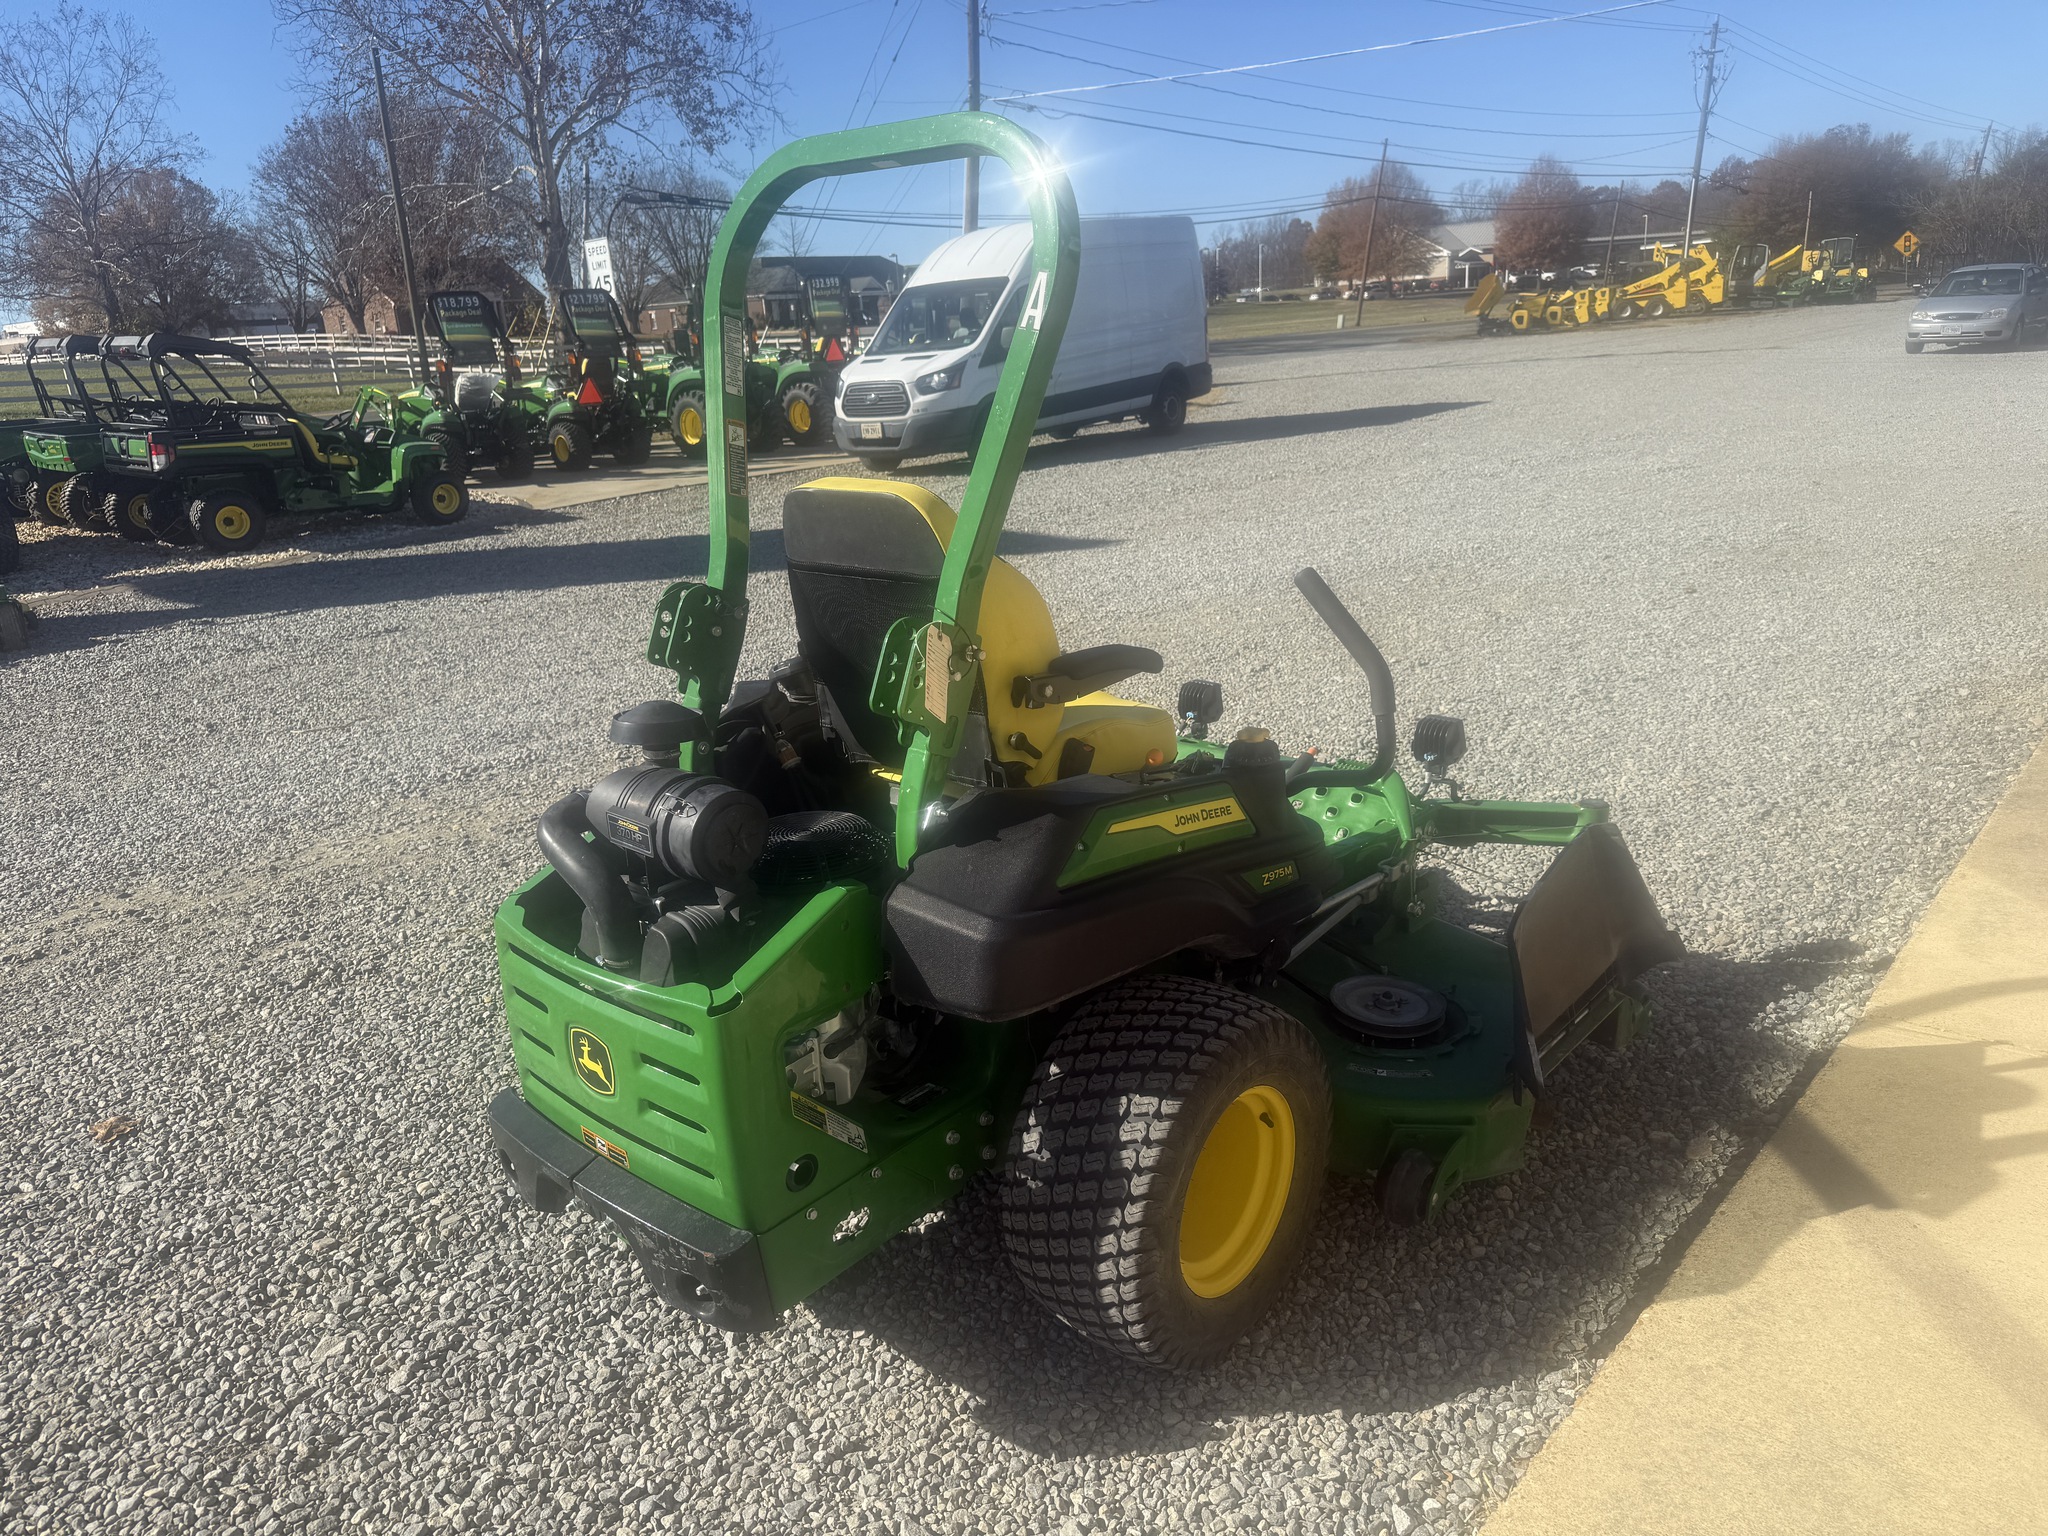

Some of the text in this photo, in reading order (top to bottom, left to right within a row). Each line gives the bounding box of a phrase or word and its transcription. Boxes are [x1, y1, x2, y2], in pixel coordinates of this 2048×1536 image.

[587, 245, 608, 257] SPEED
[591, 260, 607, 271] LIMIT
[594, 275, 612, 293] 45
[437, 296, 480, 308] $18,799
[568, 293, 605, 304] $21,799
[1020, 271, 1048, 330] A
[440, 307, 482, 318] Package Deal
[571, 304, 608, 314] Package Deal
[1174, 805, 1232, 828] JOHN DEERE
[630, 830, 643, 842] HP
[1261, 865, 1293, 886] Z975M
